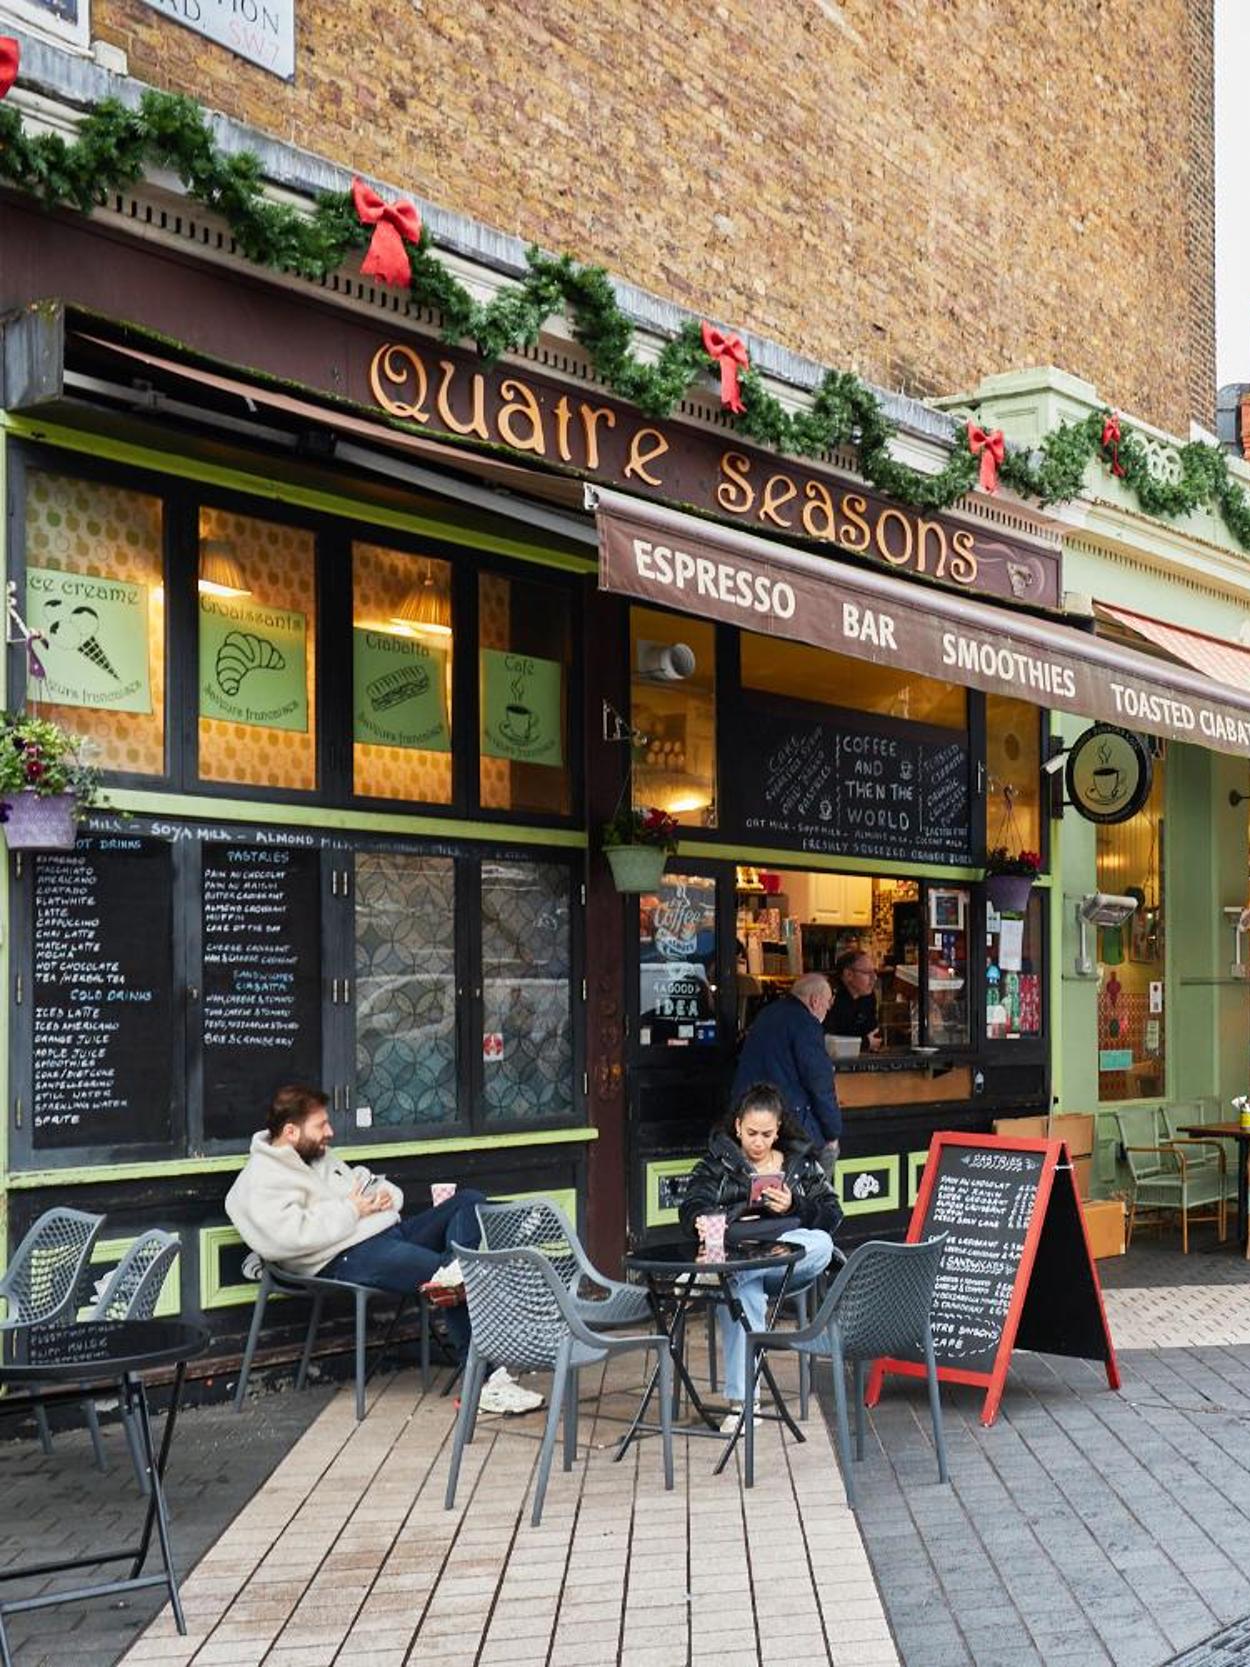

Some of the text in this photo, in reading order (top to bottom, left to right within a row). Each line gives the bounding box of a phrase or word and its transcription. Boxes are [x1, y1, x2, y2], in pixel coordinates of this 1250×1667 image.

[228, 20, 280, 67] SW7
[29, 575, 54, 592] ce
[633, 539, 796, 619] ESPRESSO
[842, 602, 897, 650] BAR
[943, 633, 1076, 698] SMOOTHIES
[1110, 683, 1195, 729] TOASTED
[843, 735, 897, 757] COFFEE
[854, 760, 884, 777] AND
[845, 781, 886, 800] THEN
[890, 783, 913, 801] THE
[848, 808, 910, 830] WORLD
[151, 822, 193, 843] SOYA
[197, 828, 232, 841] MILK
[256, 831, 314, 845] ALMOND
[226, 850, 290, 864] PASTRIES
[38, 908, 68, 918] LATTE
[64, 930, 96, 940] LATTE
[667, 983, 695, 995] GOOD
[68, 1006, 100, 1019] LATTE
[655, 999, 699, 1017] IDEA
